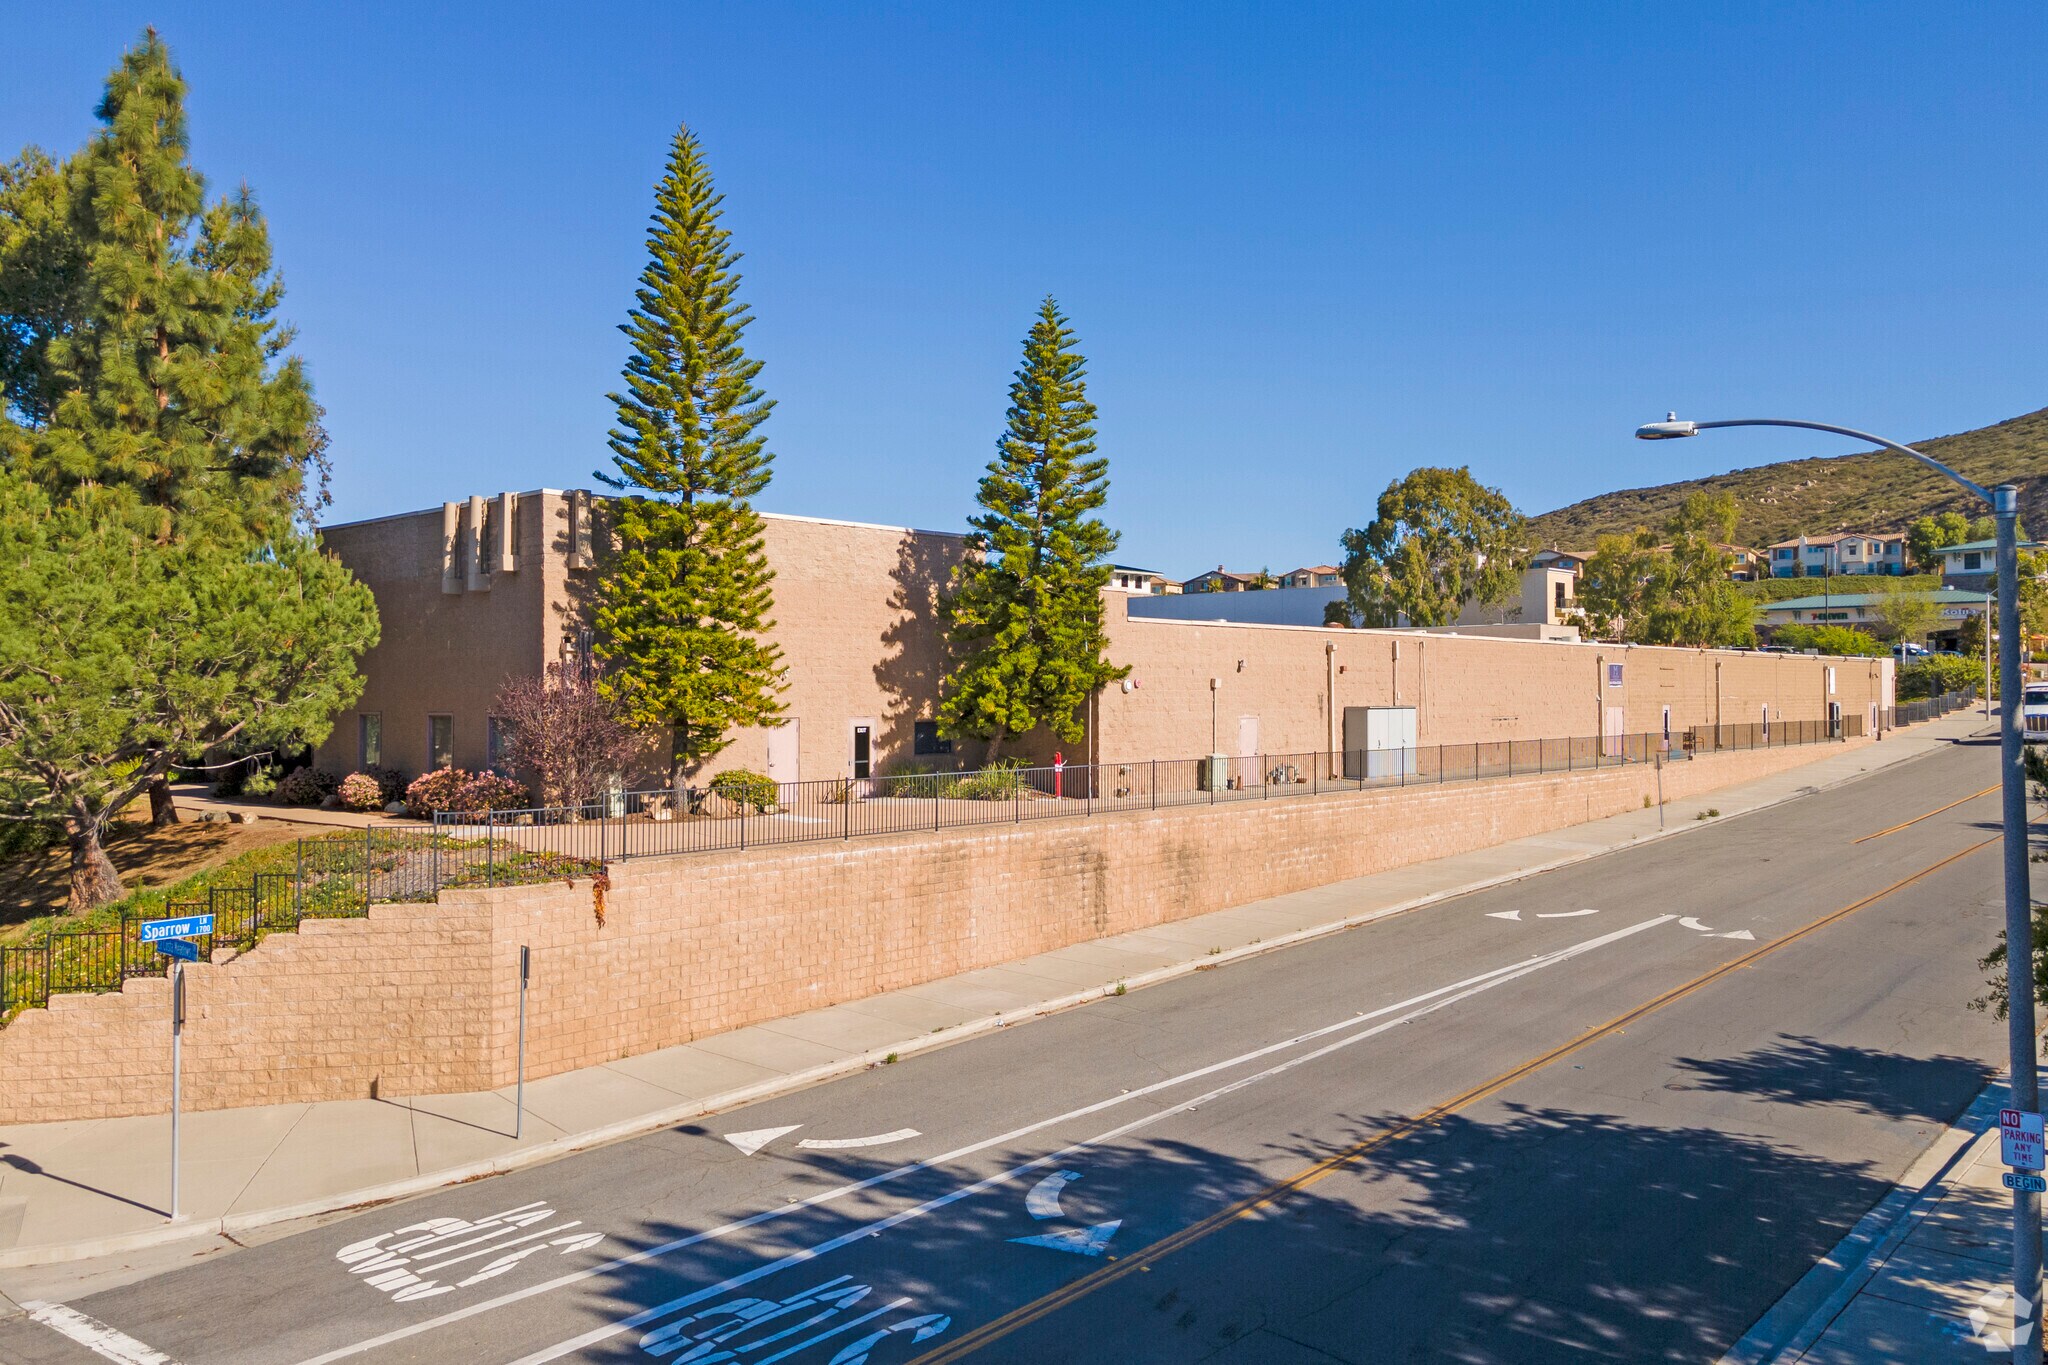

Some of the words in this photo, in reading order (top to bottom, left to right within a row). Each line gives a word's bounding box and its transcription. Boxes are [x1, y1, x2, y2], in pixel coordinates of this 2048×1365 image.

[199, 917, 208, 925] LN
[144, 923, 191, 940] Sparrow
[196, 925, 211, 934] 1700
[2002, 1111, 2018, 1126] NO
[2004, 1128, 2041, 1144] PARKING
[2014, 1143, 2032, 1153] ANY
[2013, 1152, 2033, 1163] TIME
[2006, 1176, 2042, 1190] BEGIN
[335, 1200, 606, 1303] STOP
